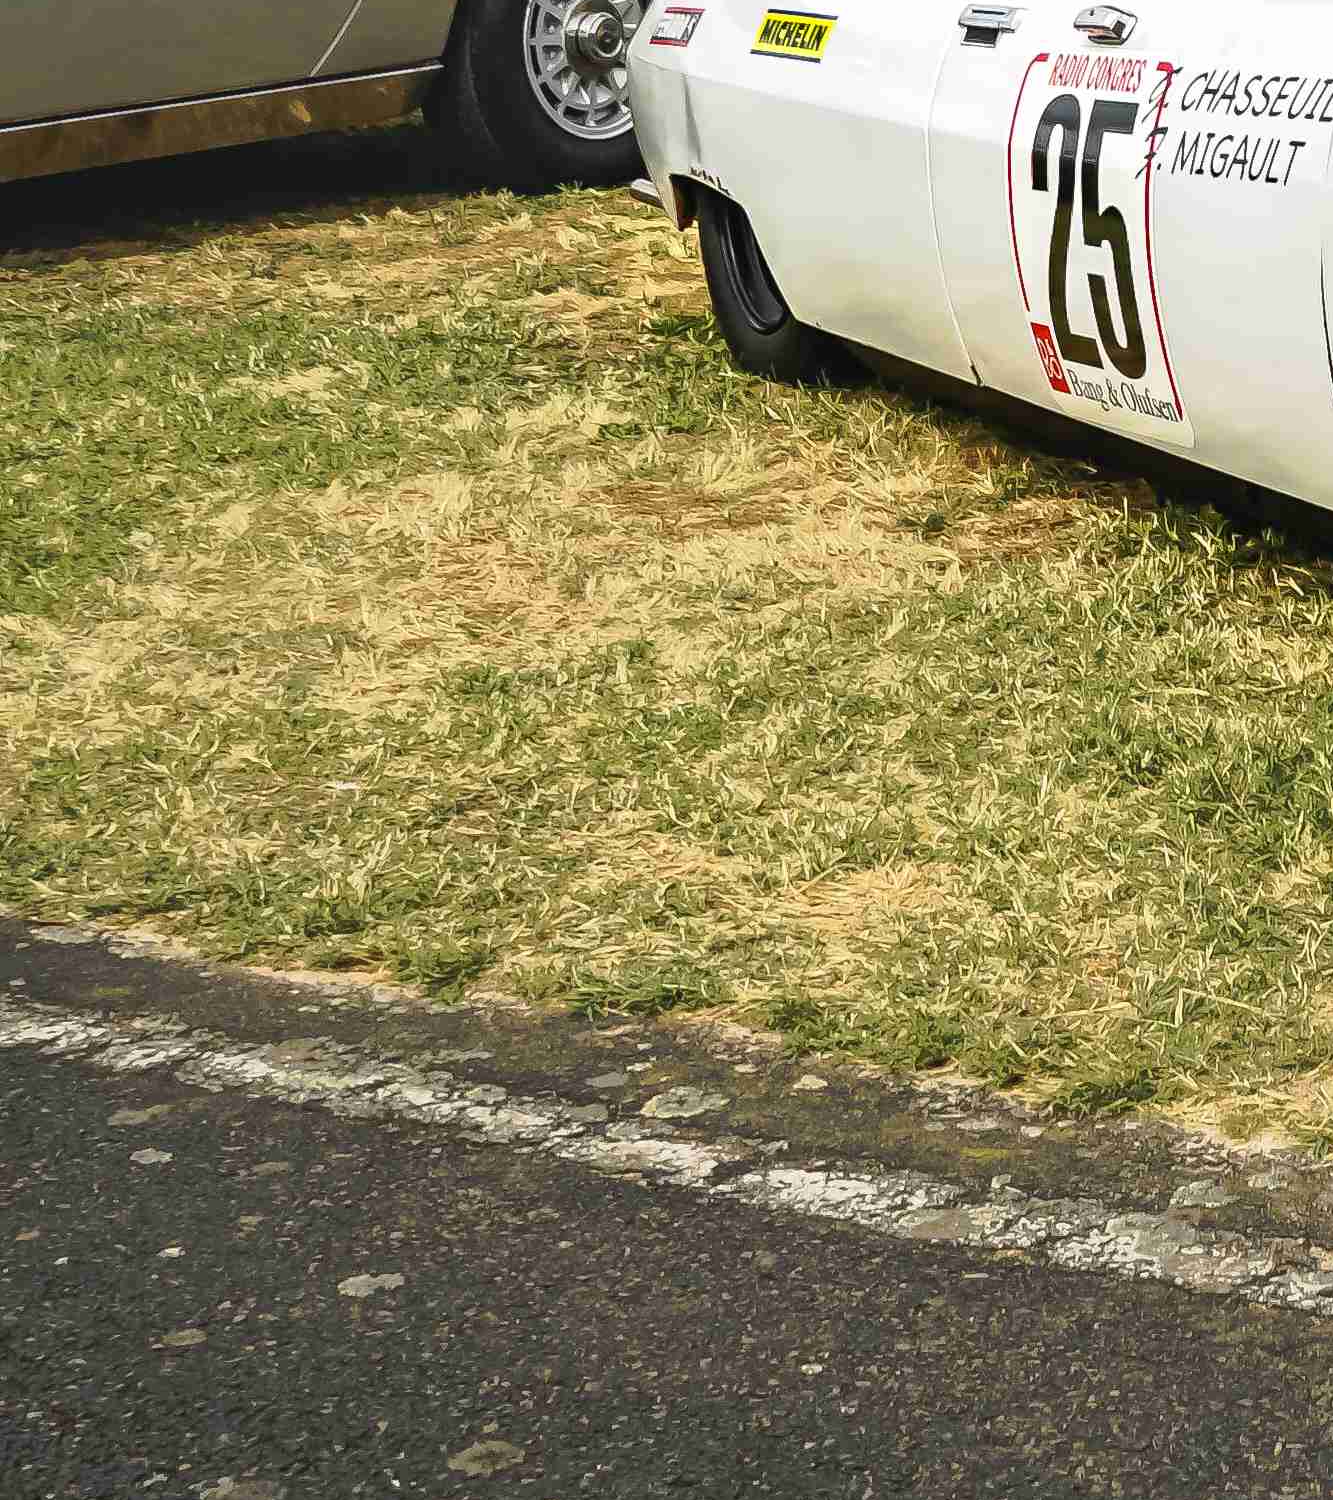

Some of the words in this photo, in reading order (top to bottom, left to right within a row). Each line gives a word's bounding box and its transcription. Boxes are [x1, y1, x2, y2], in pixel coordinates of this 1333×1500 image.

[758, 18, 829, 52] MICHELIN
[1048, 53, 1090, 89] RADIO
[1171, 130, 1307, 186] MIGAULT
[1030, 93, 1148, 380] 25
[1066, 368, 1111, 412] Bang
[1106, 377, 1123, 410] &
[1120, 381, 1180, 423] Olufsen
